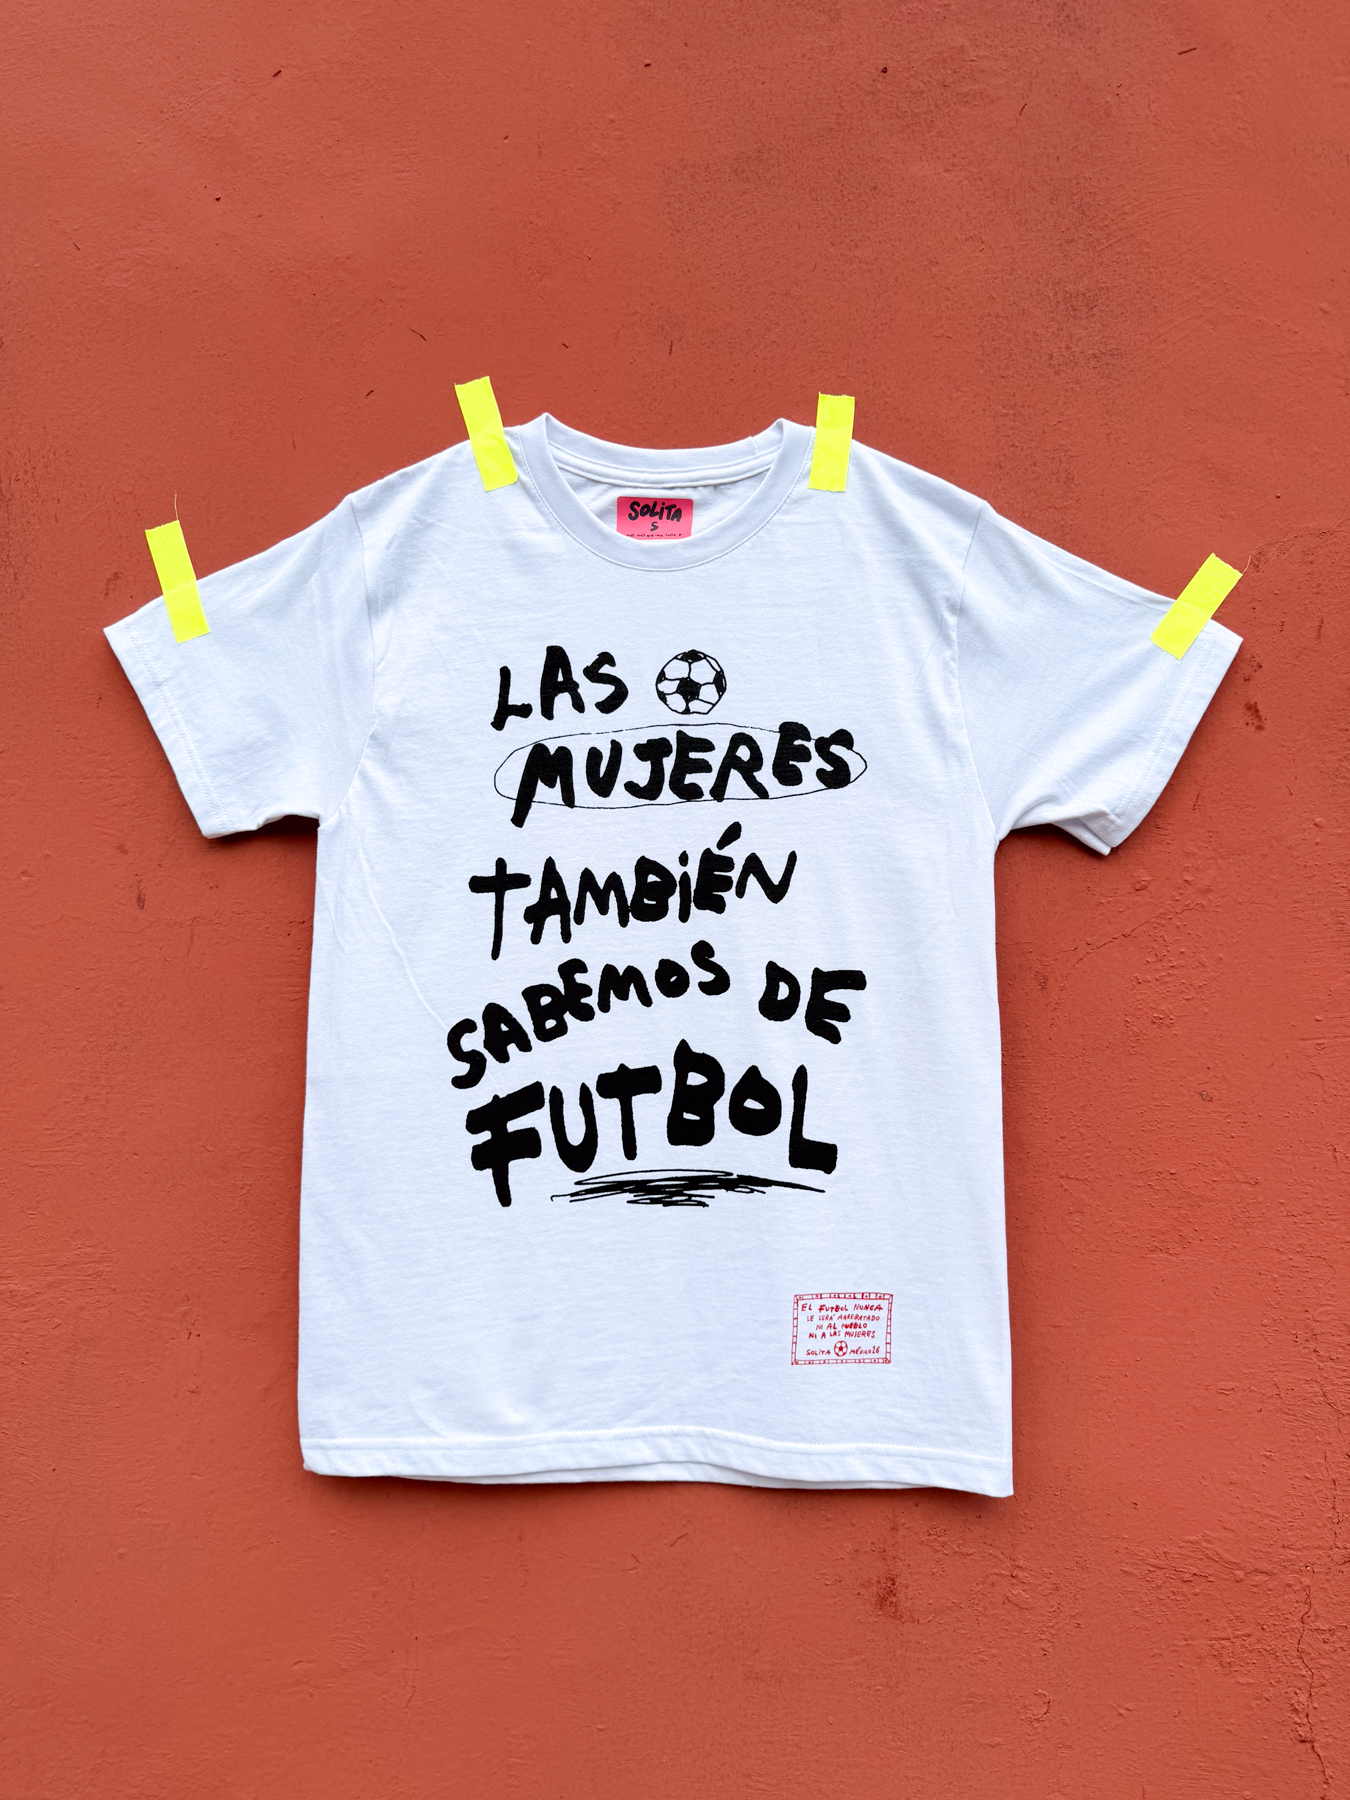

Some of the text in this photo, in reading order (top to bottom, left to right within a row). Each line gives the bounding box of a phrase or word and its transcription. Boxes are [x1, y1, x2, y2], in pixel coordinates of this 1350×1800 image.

[650, 521, 659, 532] S
[490, 645, 629, 732] LAS
[505, 721, 868, 829] MUJERES
[446, 939, 867, 1090] SABEMOS DE
[465, 1038, 838, 1208] FUTBOL
[801, 1303, 812, 1311] EL
